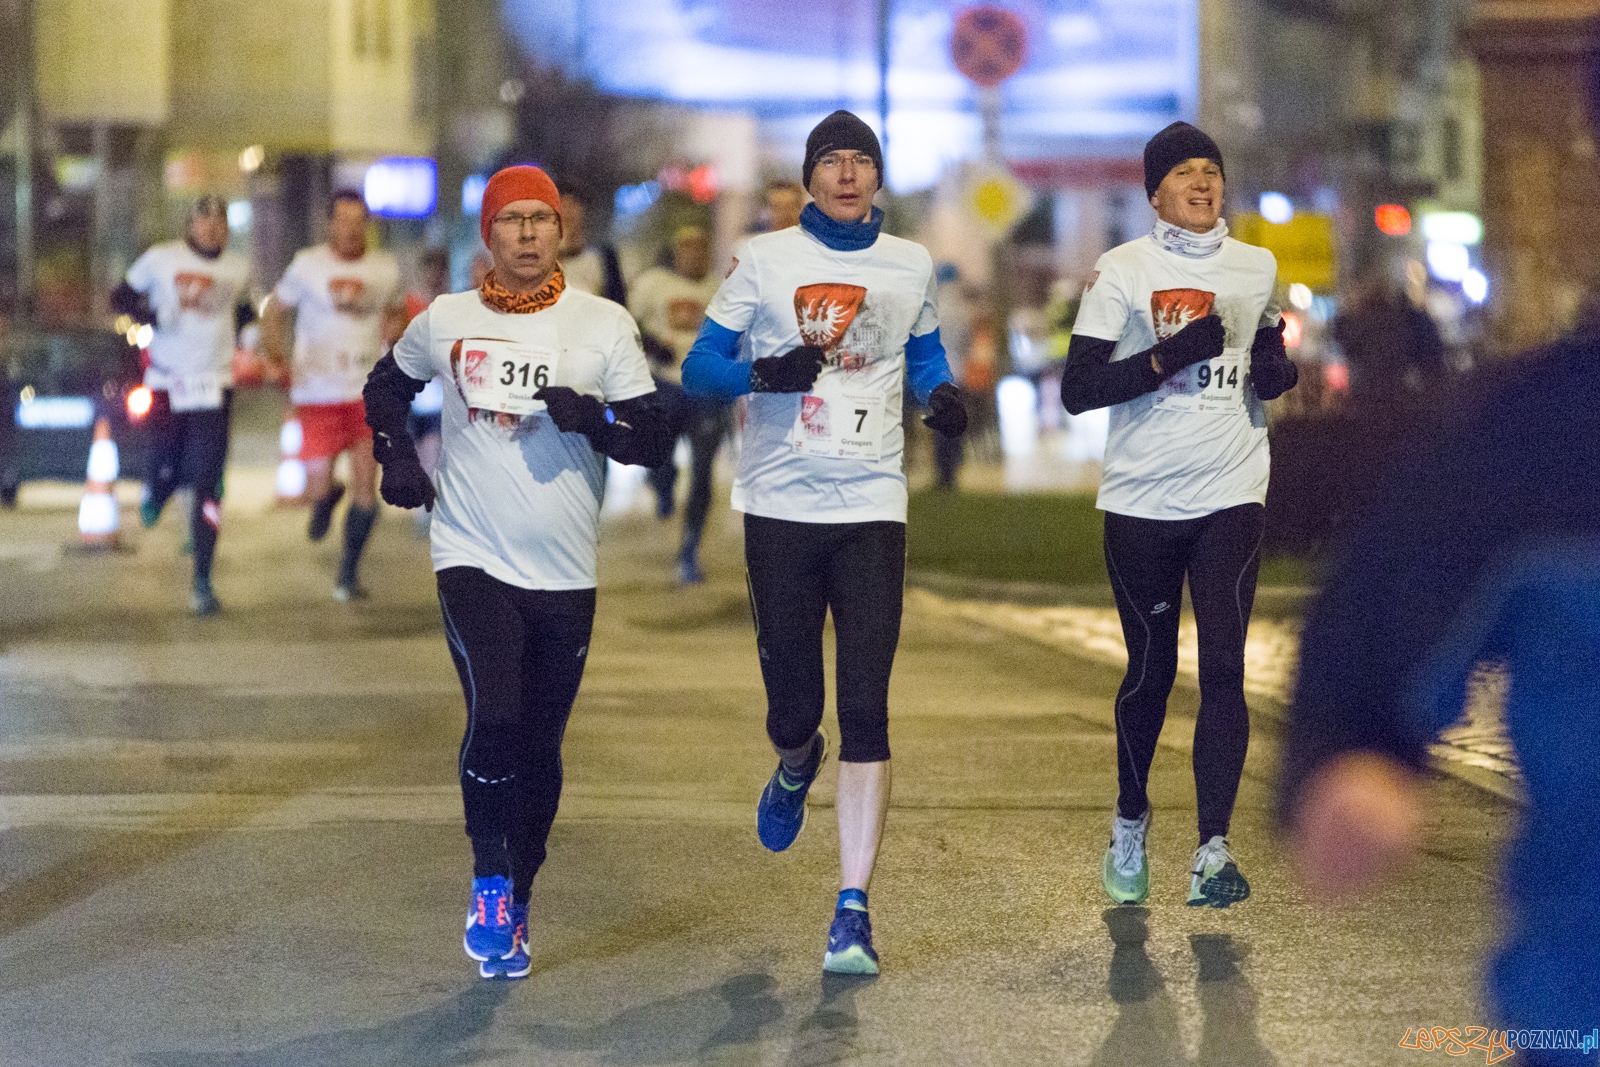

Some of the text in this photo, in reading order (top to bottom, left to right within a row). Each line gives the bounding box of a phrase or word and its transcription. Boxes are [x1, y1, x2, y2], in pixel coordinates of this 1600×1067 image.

[500, 360, 549, 390] 316
[1197, 364, 1238, 389] 914
[508, 392, 533, 401] Danie
[854, 409, 868, 433] 7
